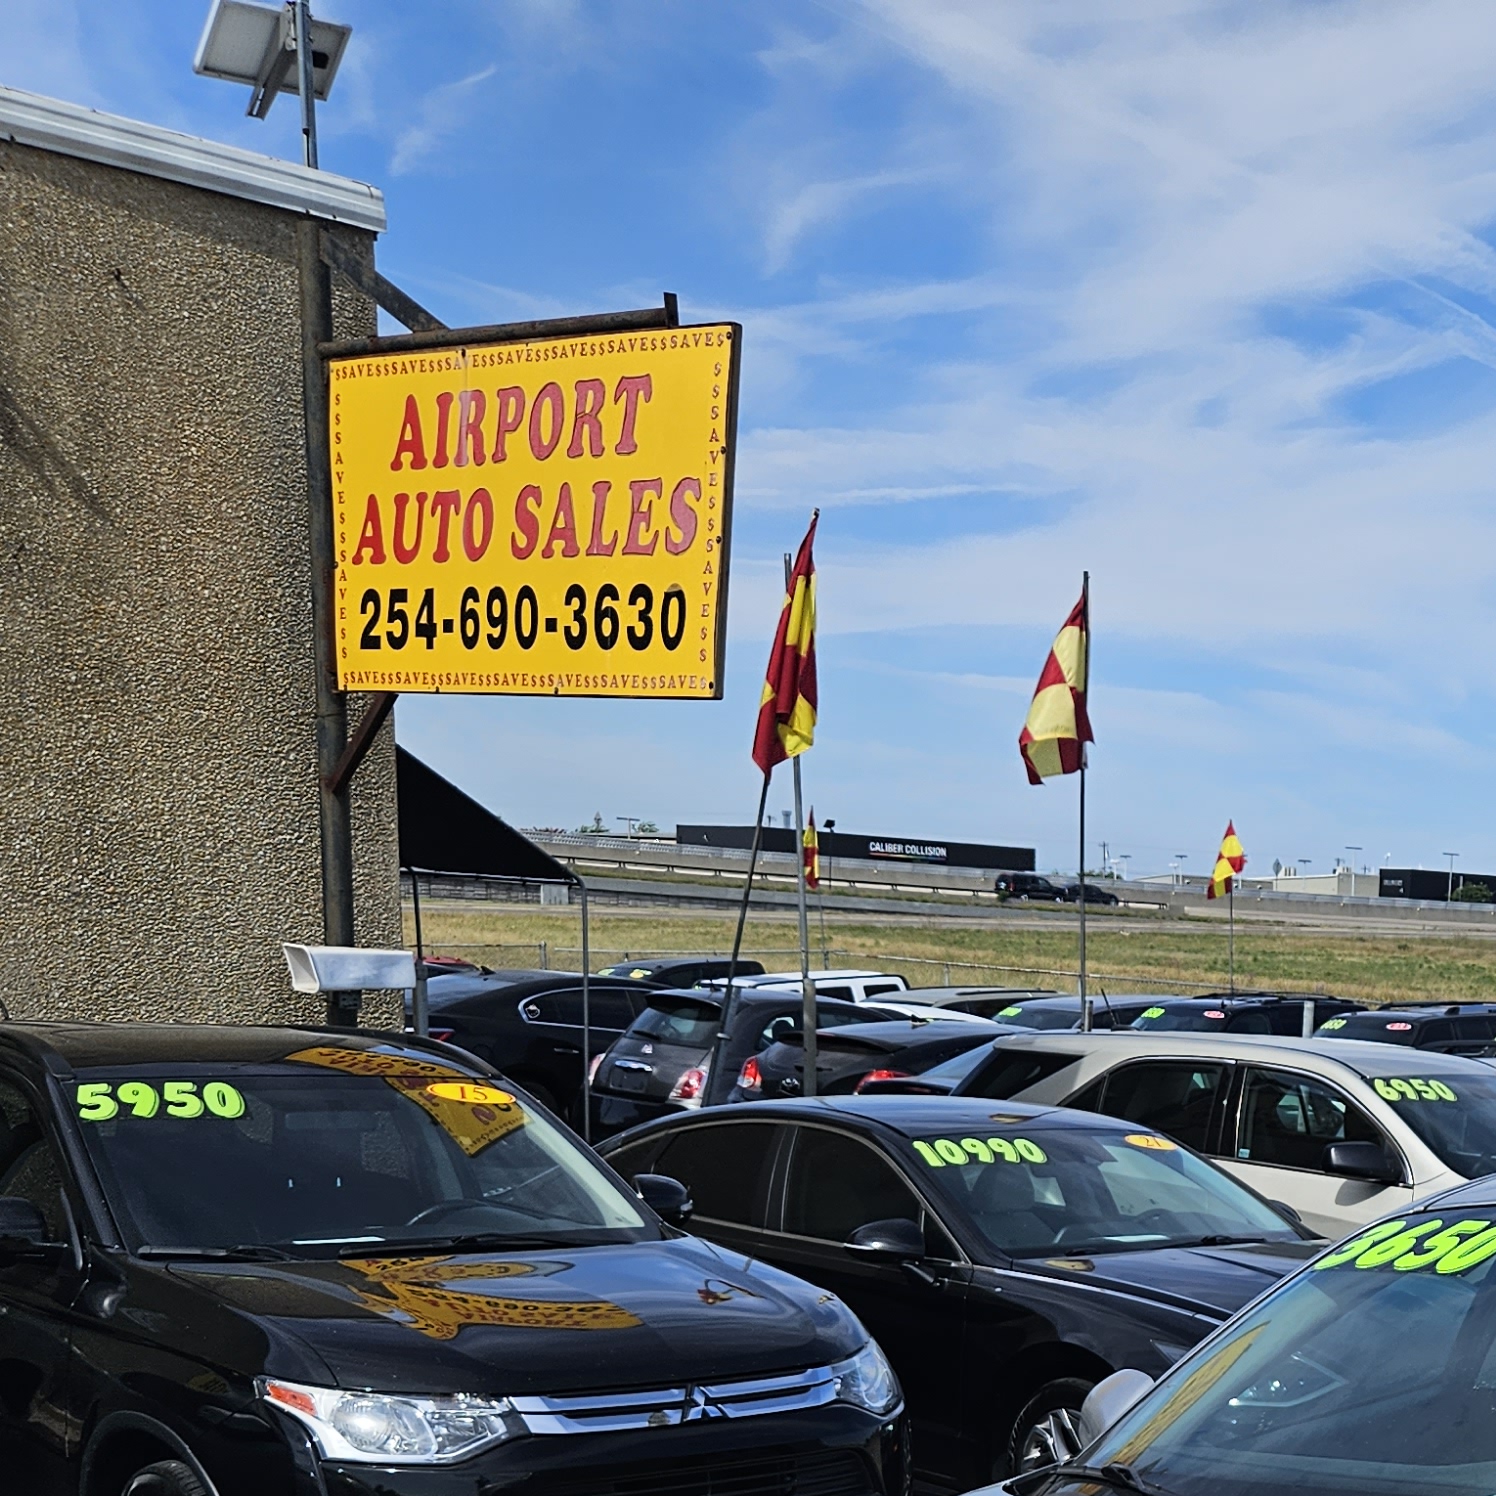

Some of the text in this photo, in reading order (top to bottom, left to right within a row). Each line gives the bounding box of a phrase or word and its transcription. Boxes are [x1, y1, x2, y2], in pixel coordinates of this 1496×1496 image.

[390, 373, 652, 472] AIRPORT
[352, 476, 701, 565] AUTO SALES
[359, 582, 687, 651] 254-690-3630
[869, 841, 948, 857] CALIBER COLLISION
[77, 1081, 246, 1121] 5950
[459, 1085, 488, 1101] 15
[1374, 1078, 1457, 1101] 6950
[912, 1137, 1048, 1167] 10990
